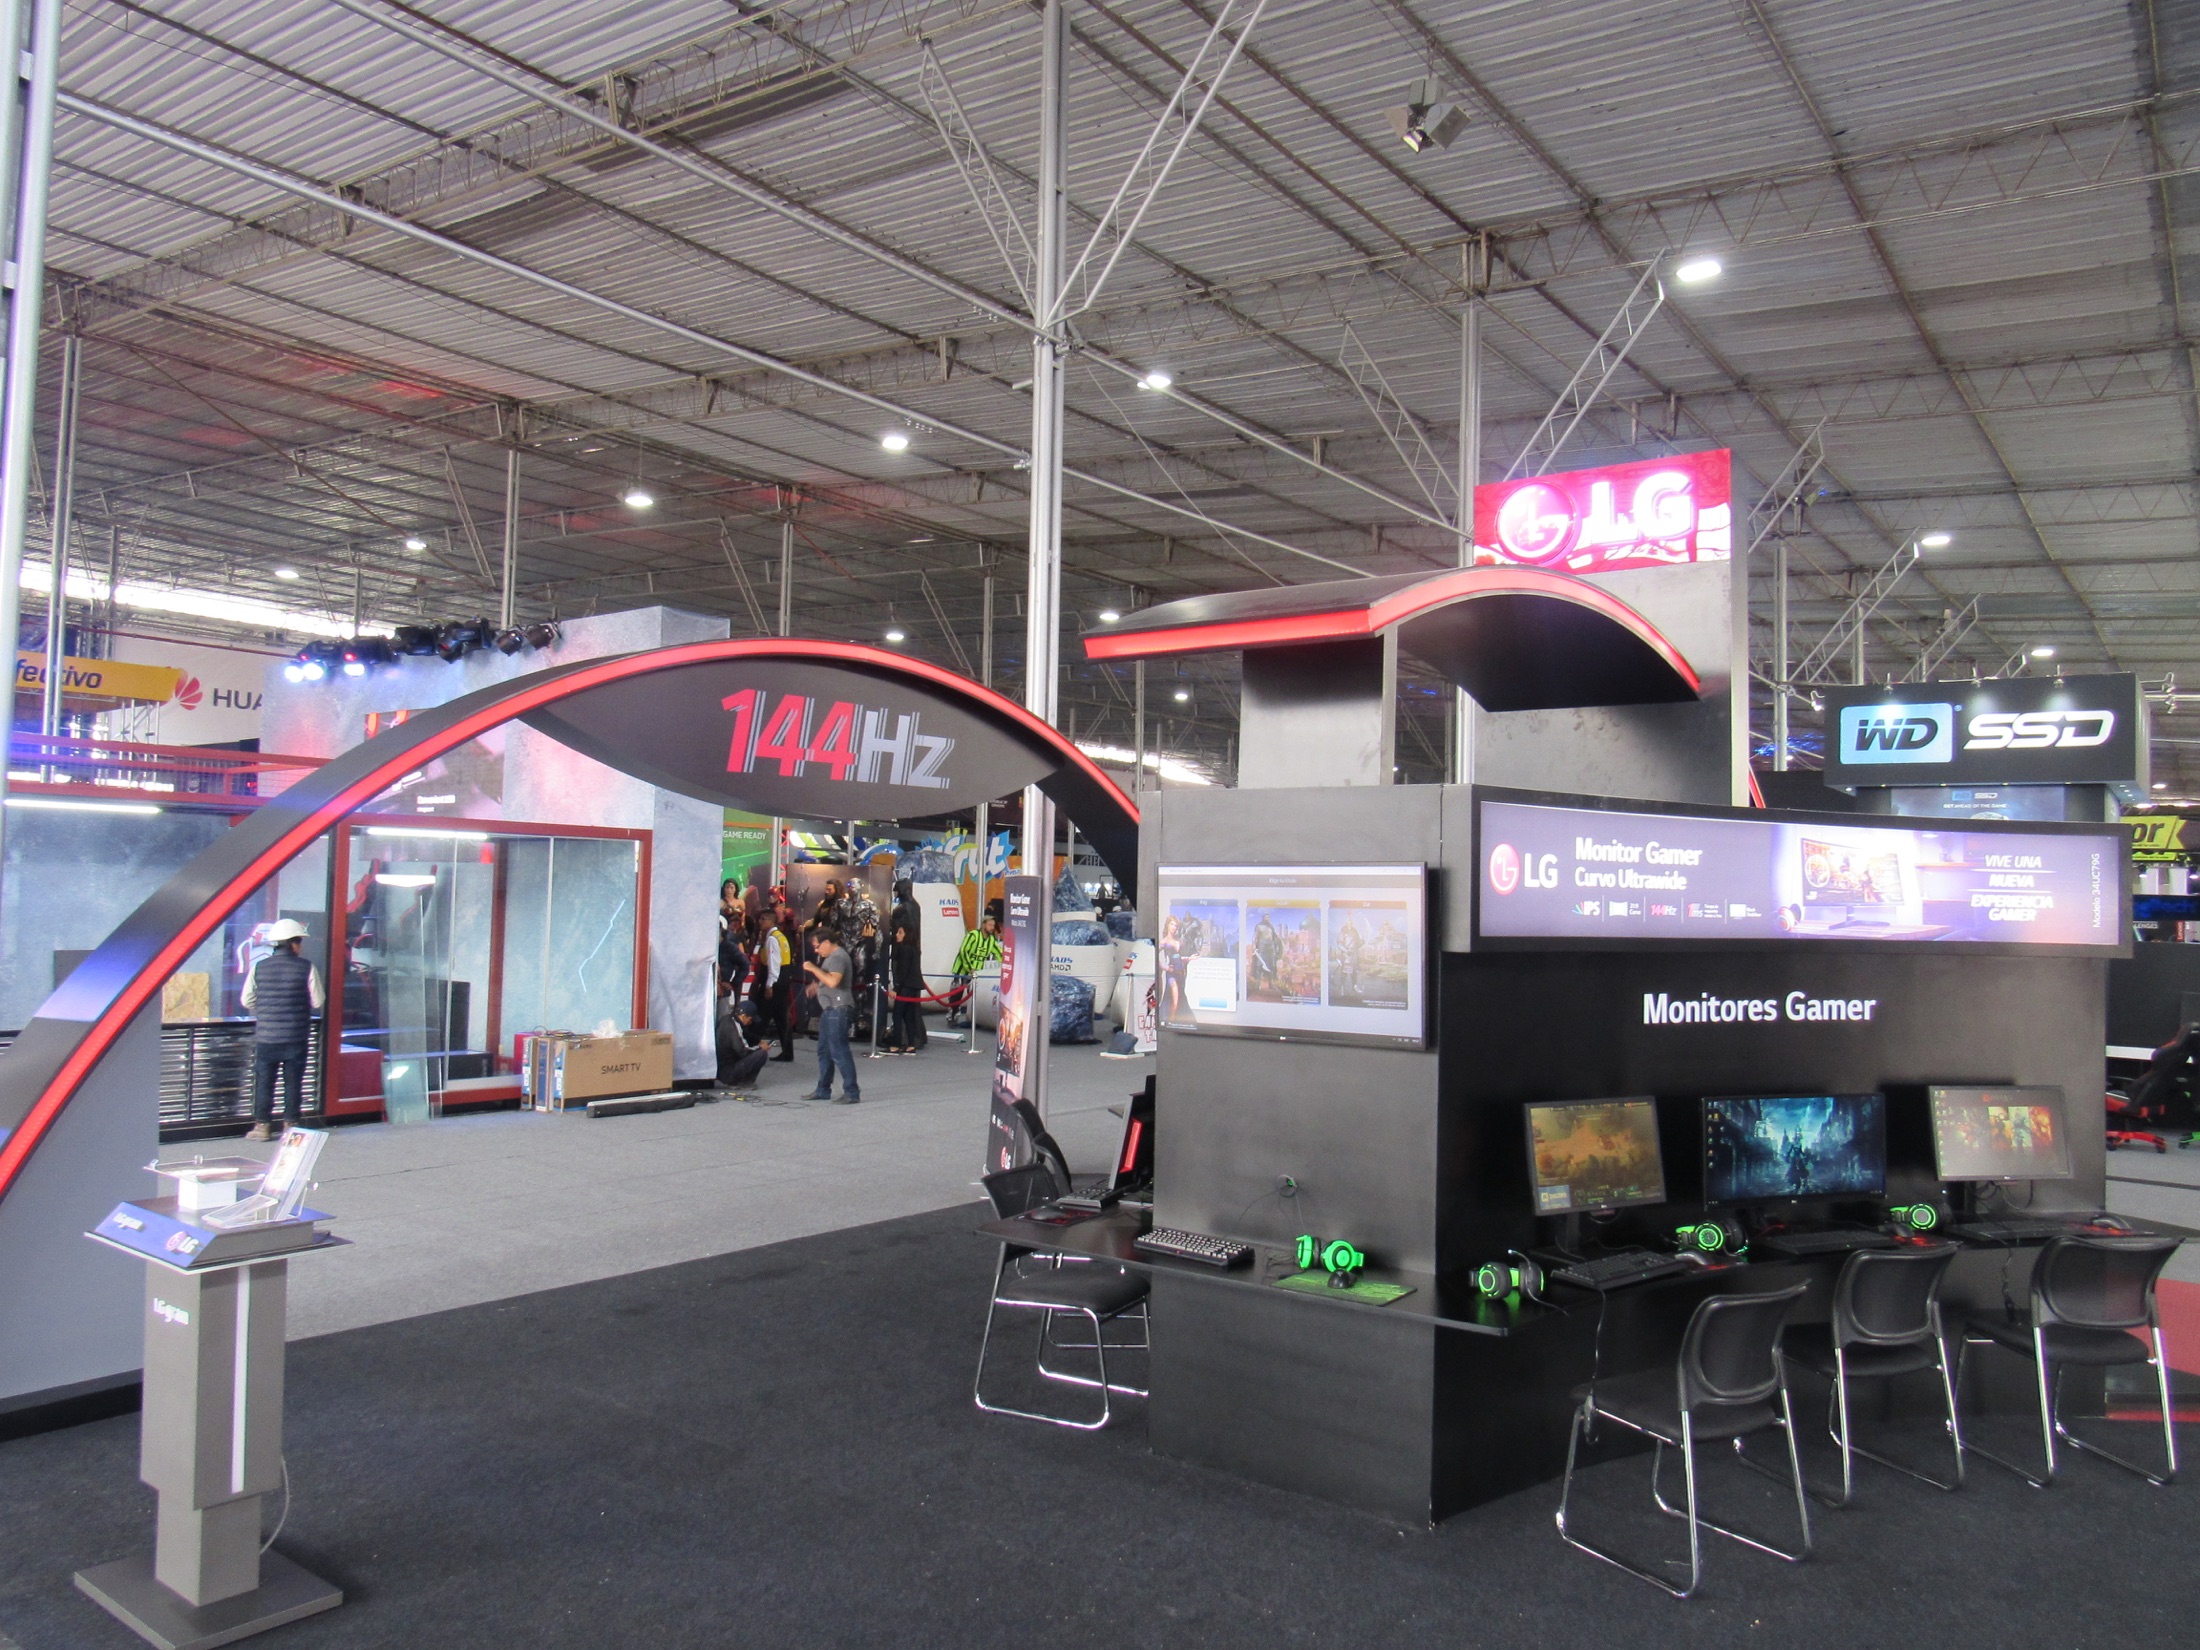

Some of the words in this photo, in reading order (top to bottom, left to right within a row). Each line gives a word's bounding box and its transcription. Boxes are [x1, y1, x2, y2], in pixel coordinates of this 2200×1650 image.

[722, 689, 955, 789] 144Hz
[1855, 716, 1938, 751] WD
[1963, 710, 2114, 749] SSD
[744, 832, 767, 840] READY
[1576, 836, 1643, 863] Monitor
[1645, 841, 1703, 866] Gamer
[1524, 852, 1558, 889] LG
[1985, 854, 2013, 868] VIVE
[2014, 855, 2042, 869] UNA
[1574, 866, 1616, 888] Curvo
[1988, 874, 2035, 888] NUEVA
[2091, 853, 2101, 896] 34UC79G
[1583, 901, 1600, 916] IPS
[1651, 903, 1677, 916] 144Hz
[1970, 894, 2054, 909] EXPERIENCIA
[1988, 908, 2037, 921] GAMER
[2092, 897, 2101, 928] Modelo
[1643, 992, 1778, 1025] Monitores
[1785, 991, 1876, 1022] Gamer
[601, 1063, 629, 1075] SMART
[631, 1062, 641, 1072] TV
